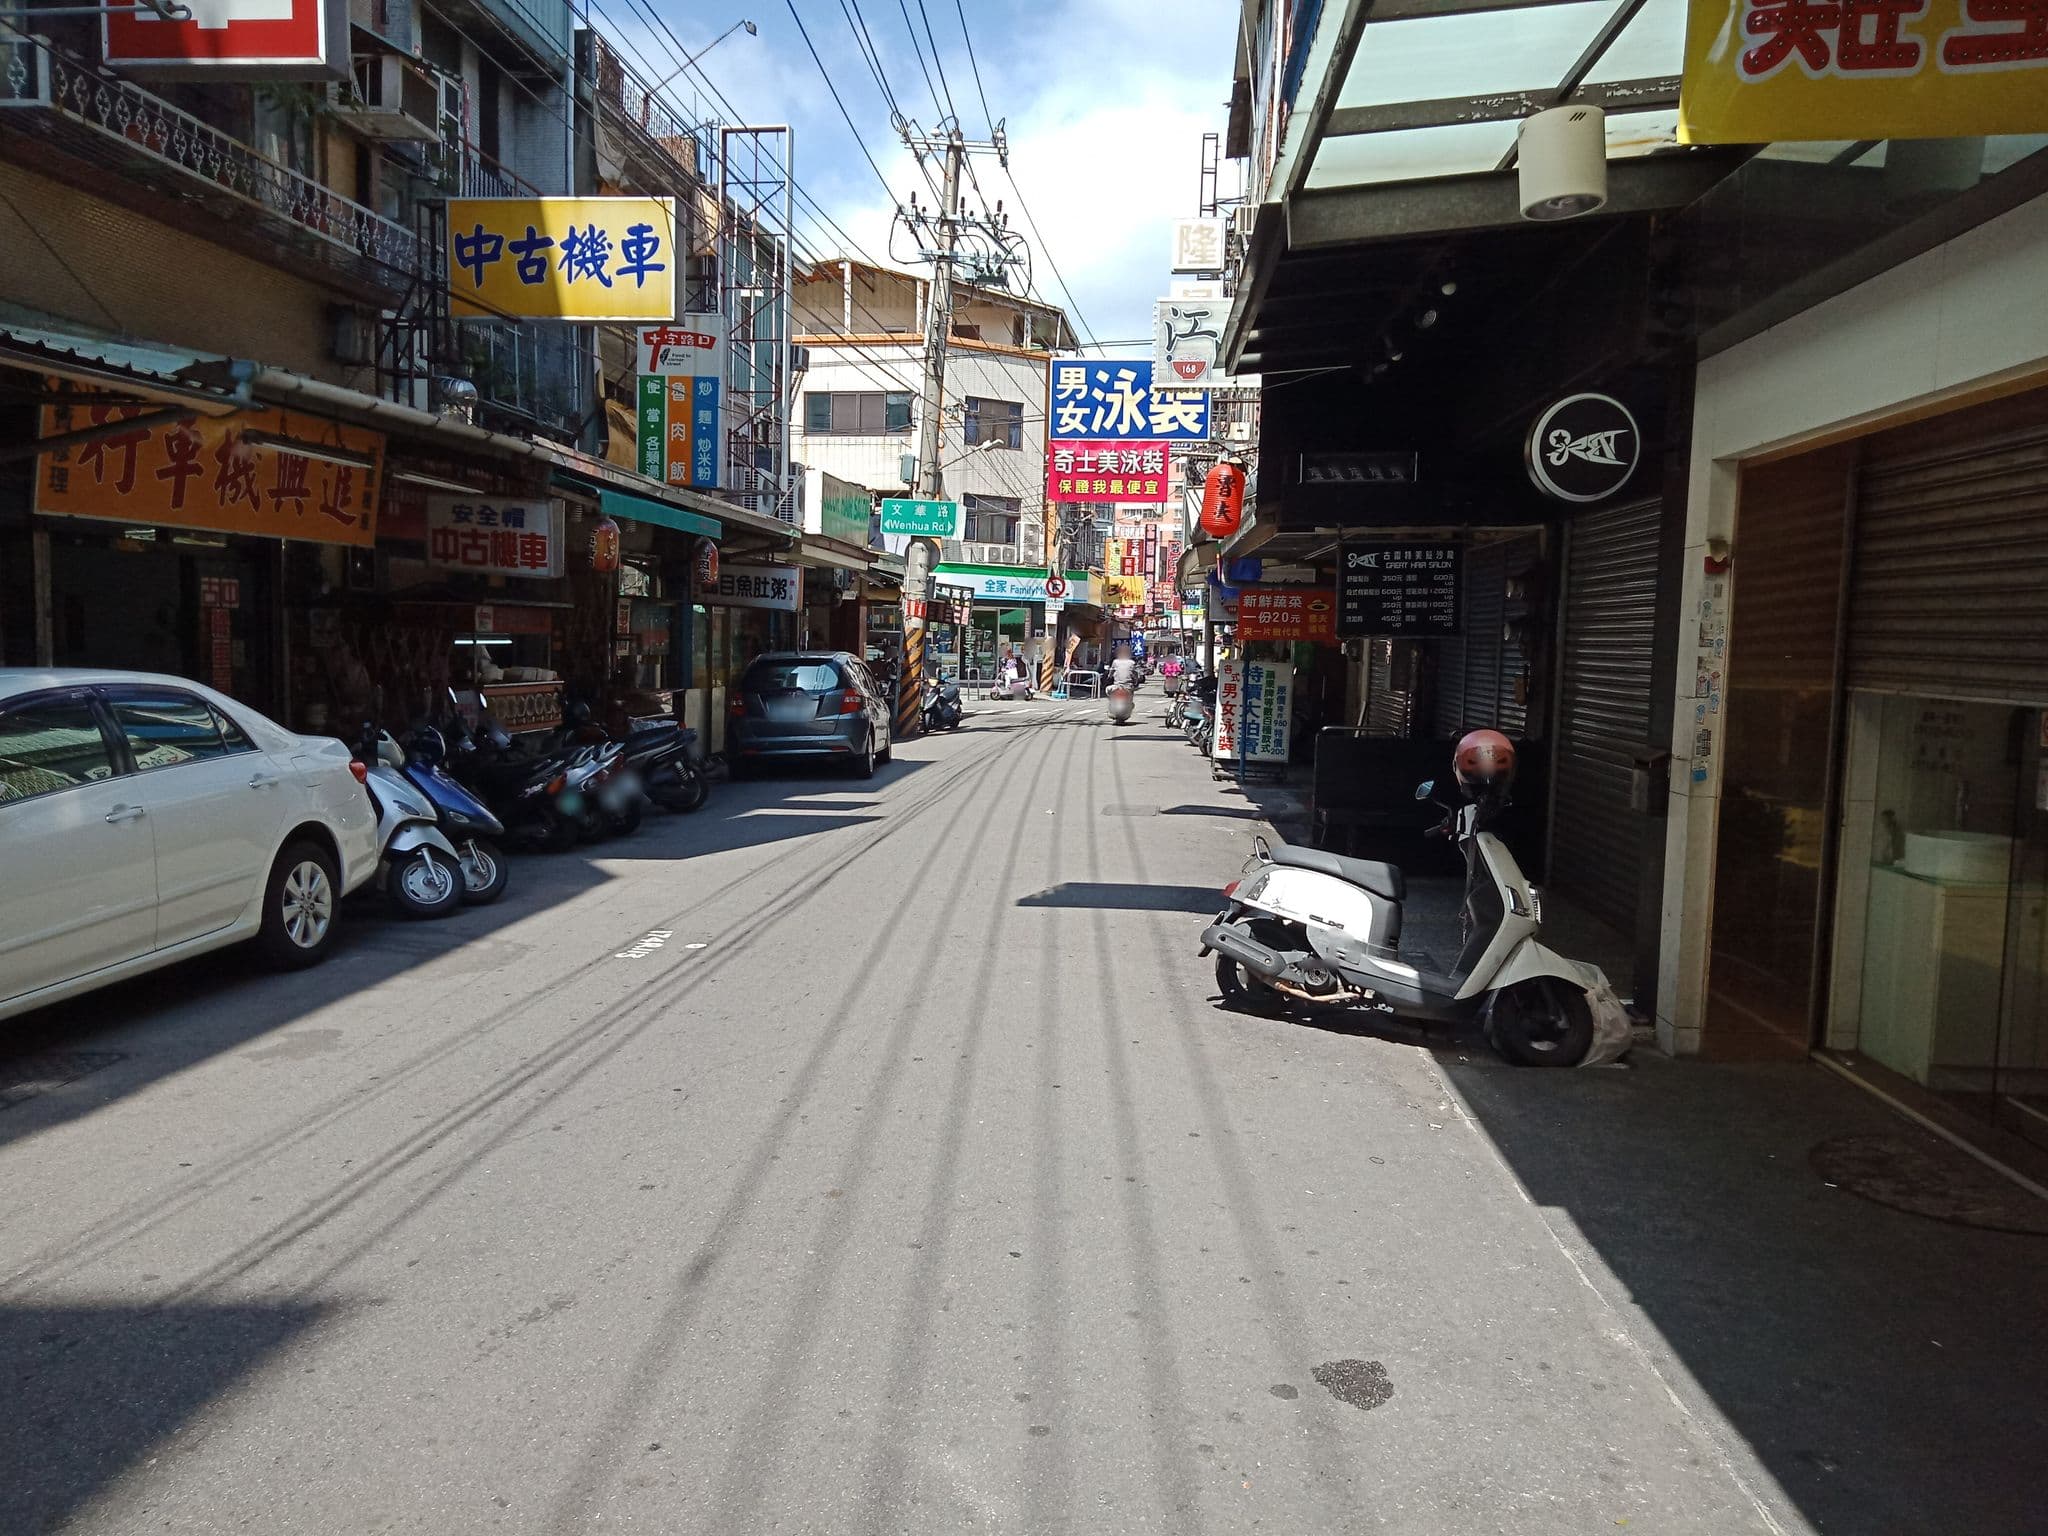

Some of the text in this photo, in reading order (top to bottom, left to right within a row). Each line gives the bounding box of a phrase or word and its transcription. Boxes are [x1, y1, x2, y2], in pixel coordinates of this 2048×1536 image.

[1178, 224, 1217, 264] 隆
[455, 223, 666, 288] 中古機車
[650, 333, 710, 346] 十字路口
[1182, 364, 1196, 374] 168
[1054, 449, 1164, 475] 奇士美泳裝
[1059, 479, 1158, 494] 保證我最便宜
[452, 503, 525, 529] 安全帽
[892, 503, 949, 518] 文華路
[890, 519, 946, 532] Wenhua Rd.
[431, 526, 548, 570] 中古機車
[985, 579, 1007, 594] 全家
[1243, 595, 1302, 608] 新鮮蔬菜
[1243, 611, 1301, 623] 一份20元
